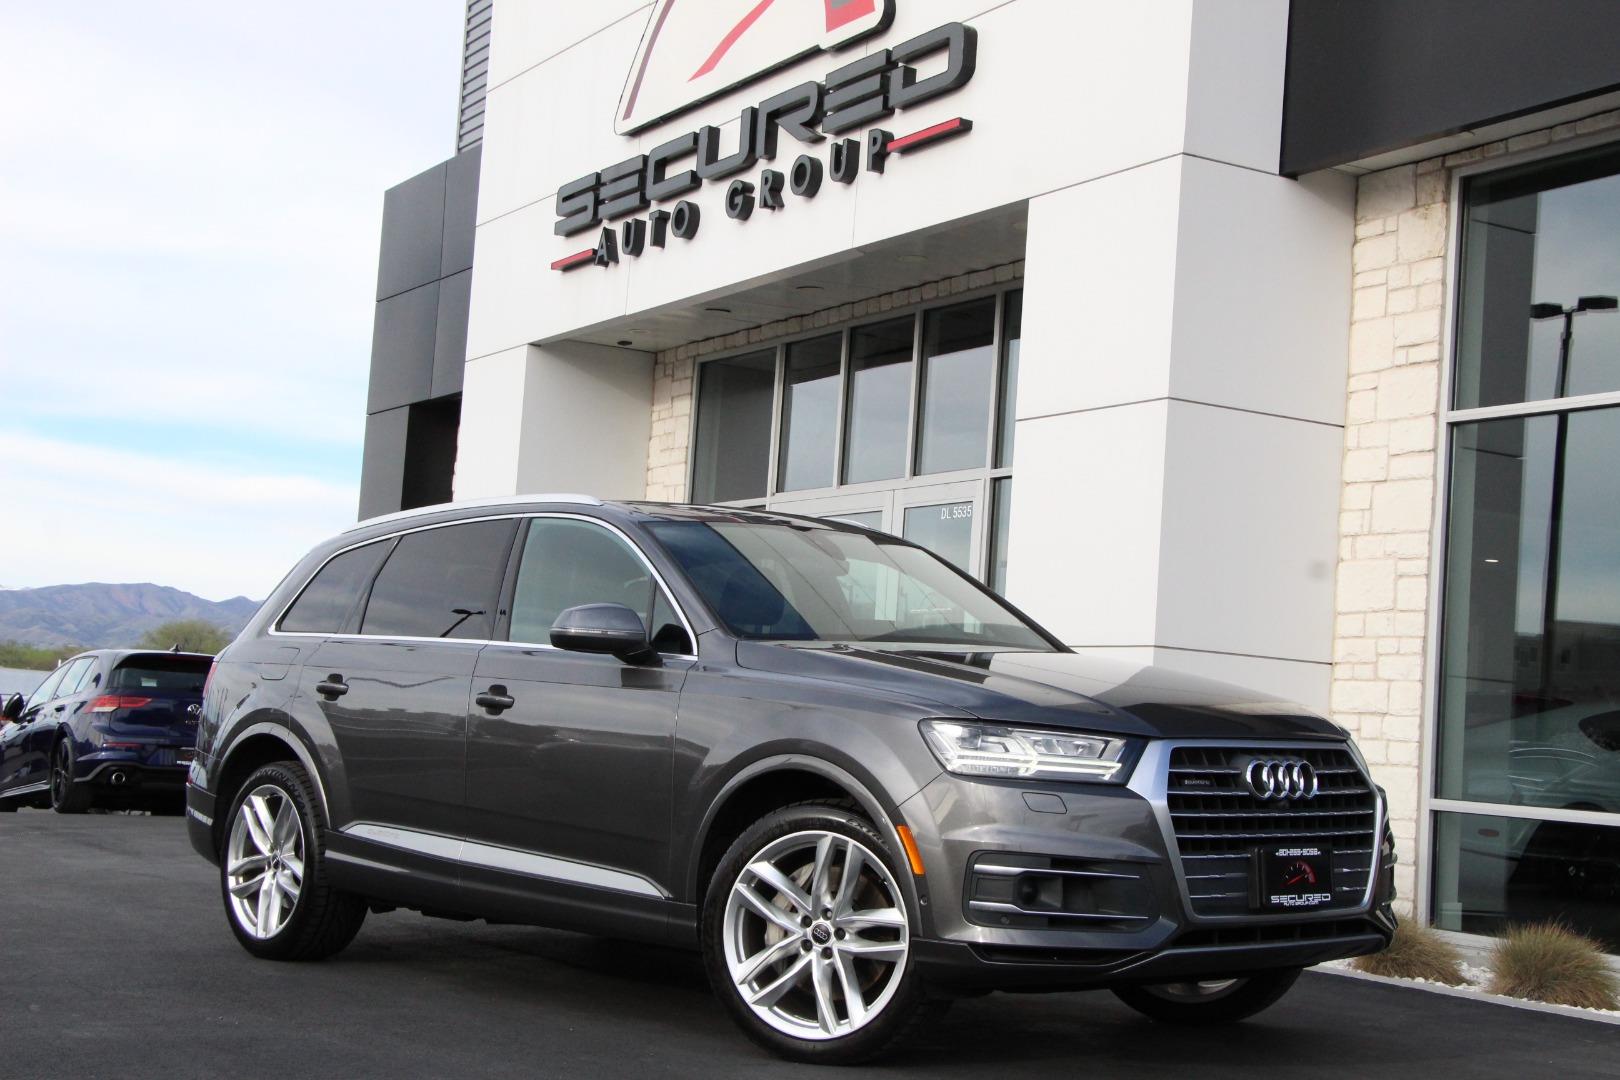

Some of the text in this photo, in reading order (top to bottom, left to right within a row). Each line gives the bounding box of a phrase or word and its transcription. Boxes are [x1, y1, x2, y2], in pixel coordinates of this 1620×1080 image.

[554, 21, 978, 237] SECURED
[594, 128, 894, 268] AUTO GROUP
[941, 505, 972, 519] DL 5535
[1271, 893, 1331, 904] SECURED
